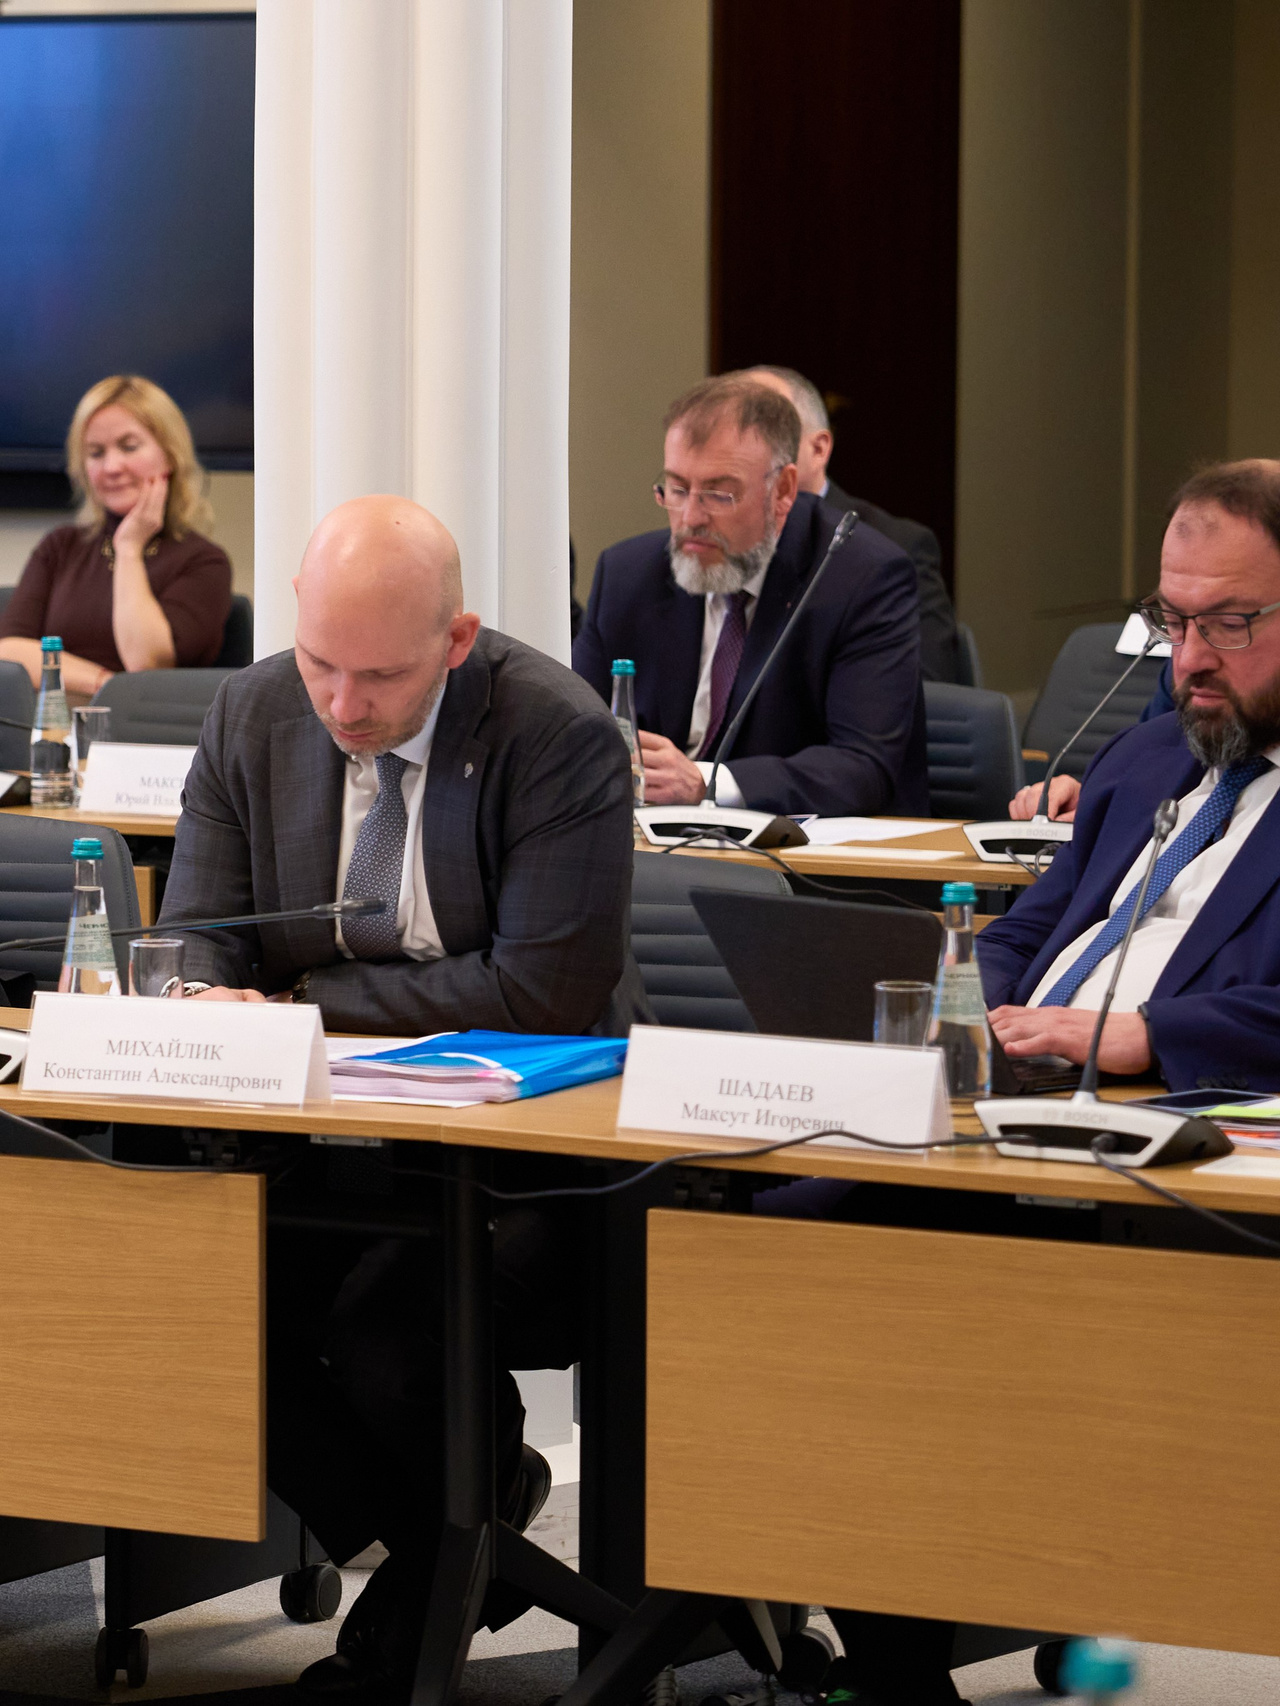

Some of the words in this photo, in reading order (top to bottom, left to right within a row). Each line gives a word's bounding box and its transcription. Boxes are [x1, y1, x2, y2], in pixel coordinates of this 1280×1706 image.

[1026, 829, 1058, 838] BOSCH
[105, 1038, 224, 1061] МИХАЙЛИК
[43, 1062, 141, 1082] Константин
[146, 1068, 282, 1092] Александрович
[718, 1078, 815, 1102] ШАДАЕВ
[681, 1103, 750, 1128] Максут
[755, 1108, 846, 1133] Игоревич
[1063, 1111, 1108, 1124] BOSCH
